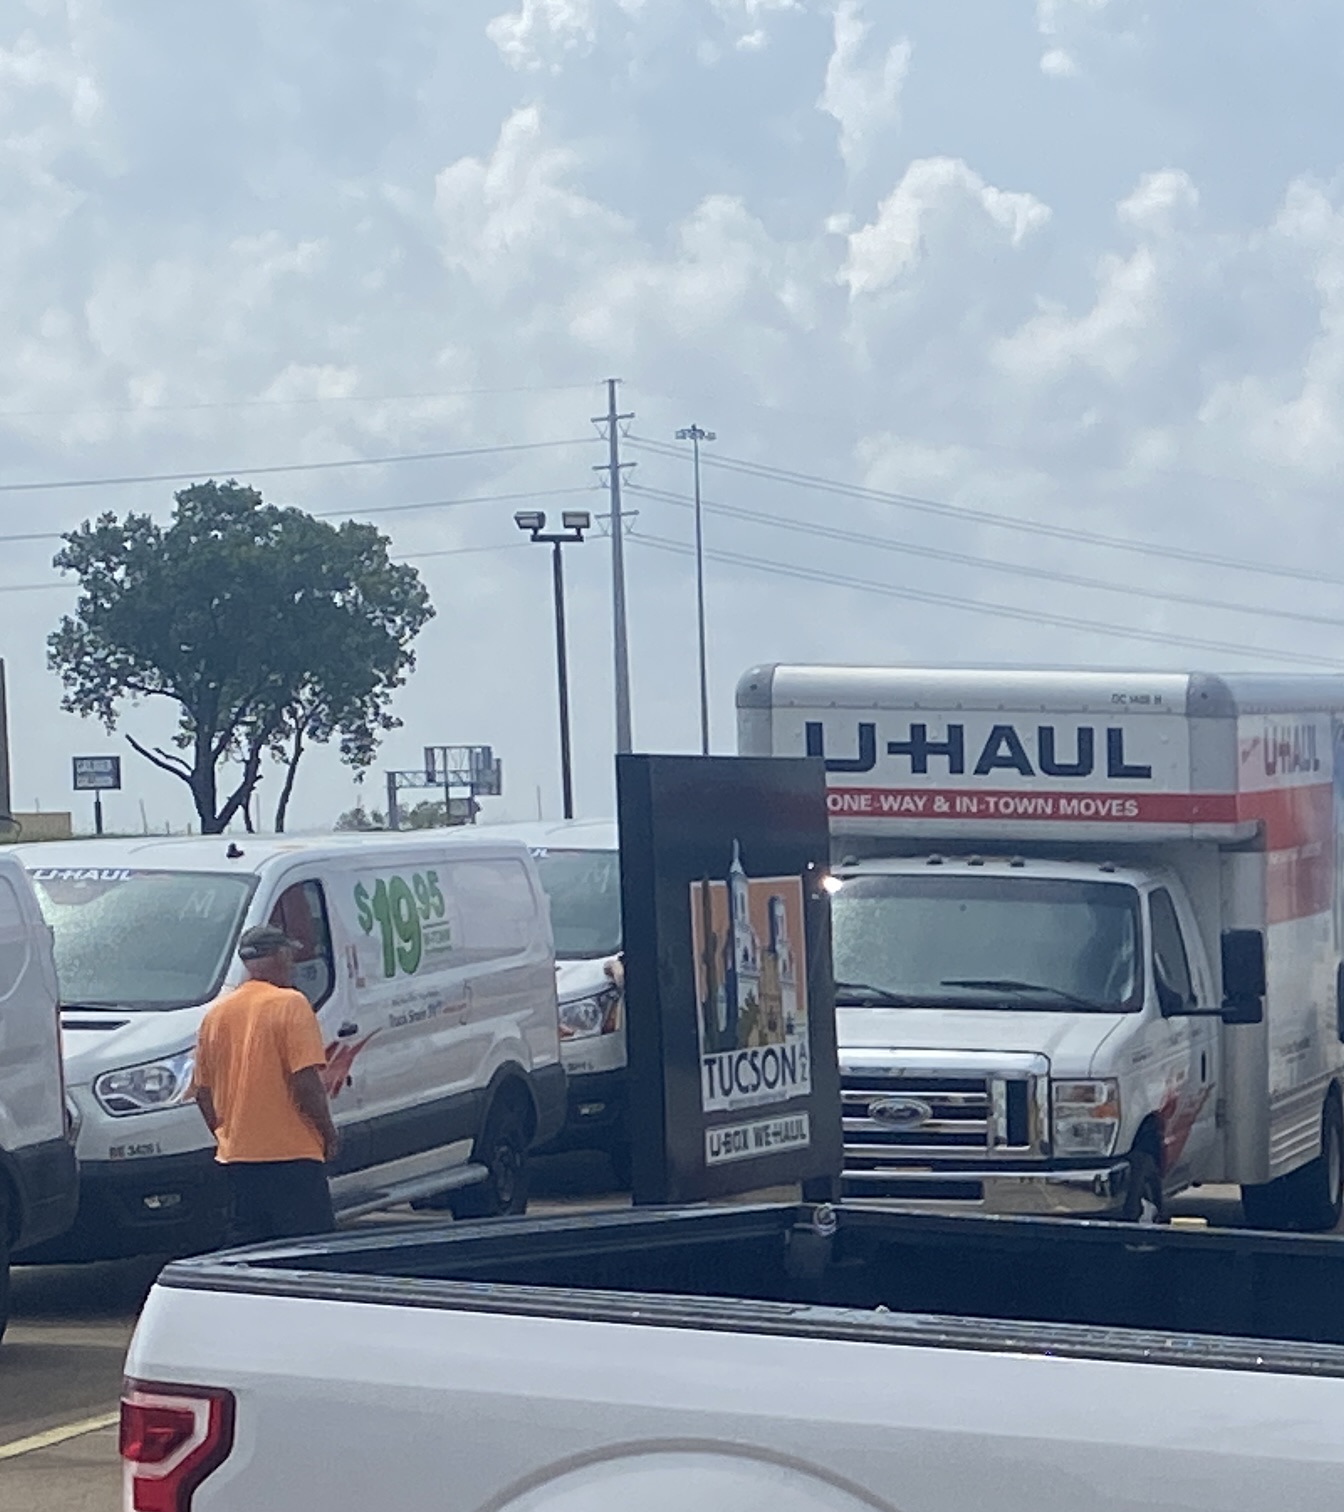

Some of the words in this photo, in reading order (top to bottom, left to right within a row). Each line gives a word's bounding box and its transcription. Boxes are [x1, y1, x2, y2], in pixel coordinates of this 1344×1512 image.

[805, 721, 1152, 779] U-HAUL
[1059, 799, 1139, 817] MOVES
[703, 1045, 798, 1099] TUCSON
